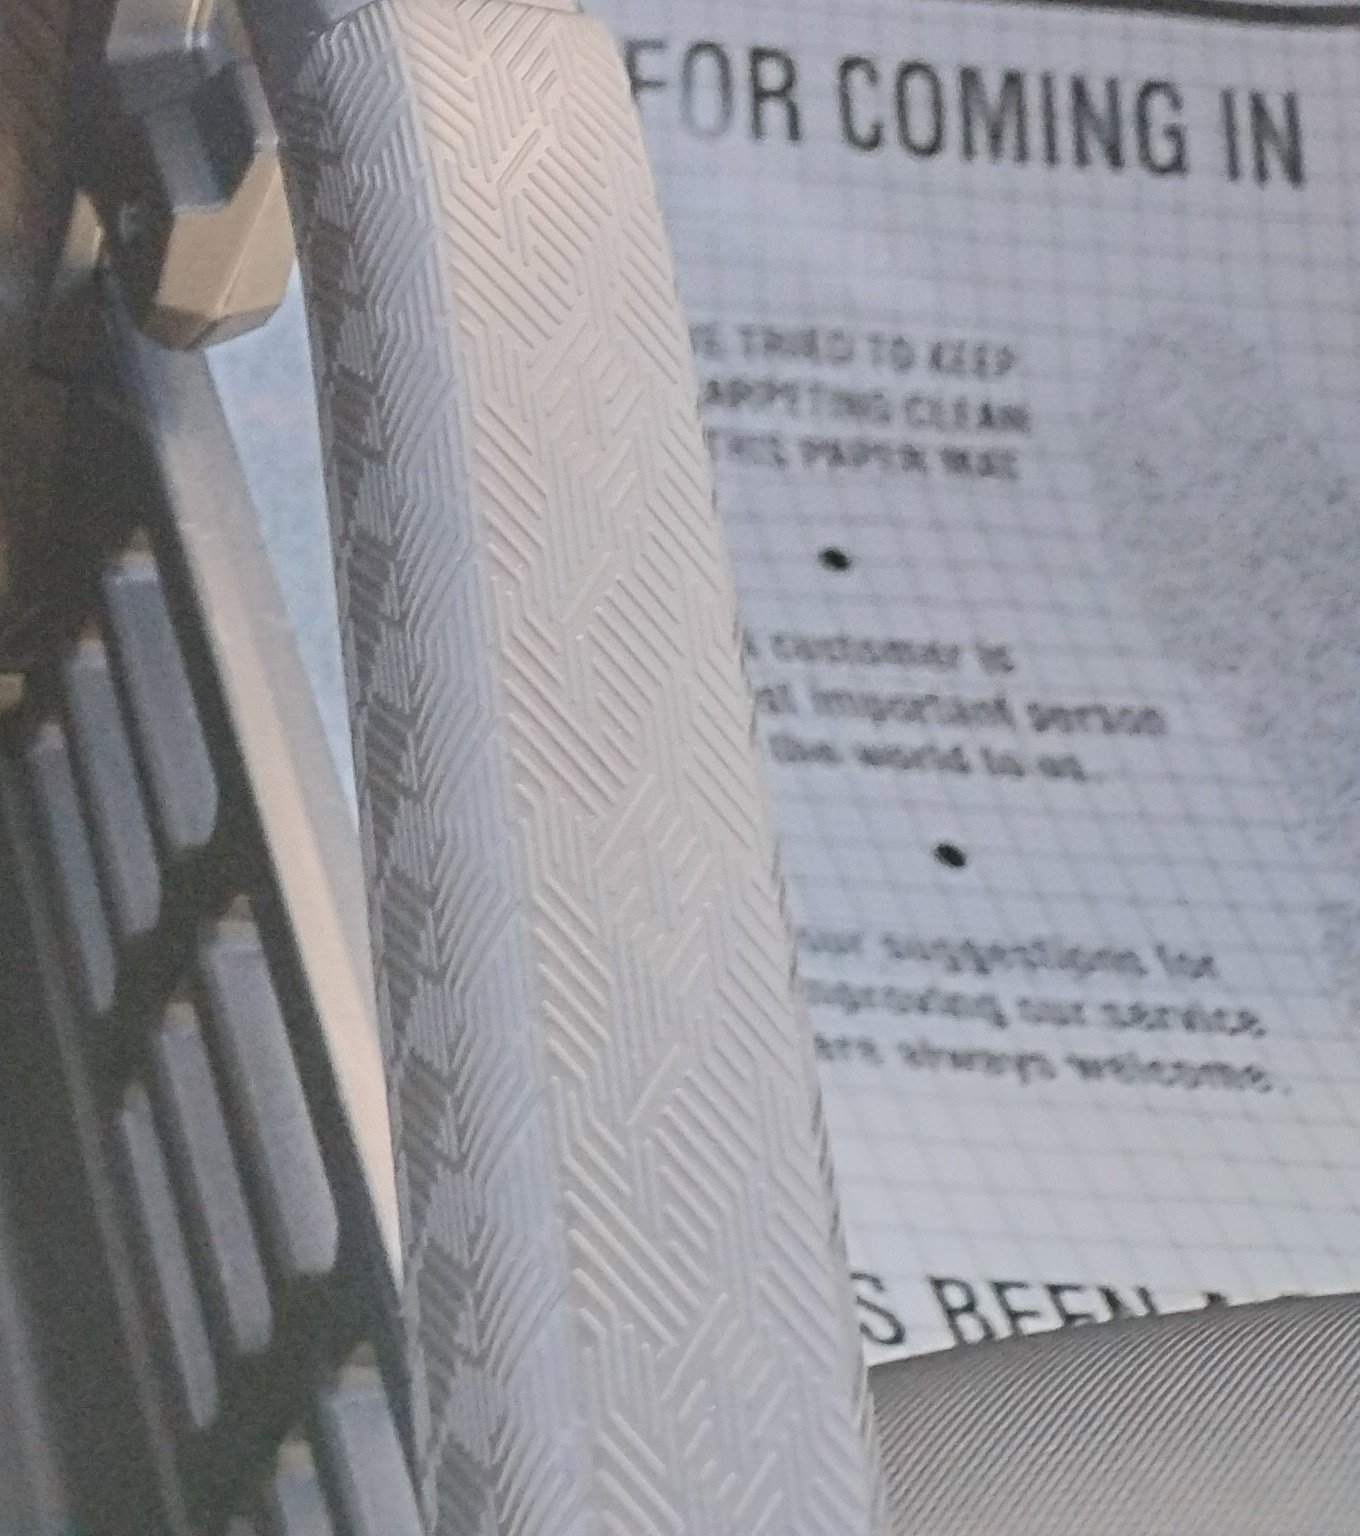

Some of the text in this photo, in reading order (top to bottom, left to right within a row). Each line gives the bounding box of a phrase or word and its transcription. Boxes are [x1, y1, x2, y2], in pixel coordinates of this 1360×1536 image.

[625, 38, 1307, 189] FOR COMING IN
[868, 331, 916, 372] TO
